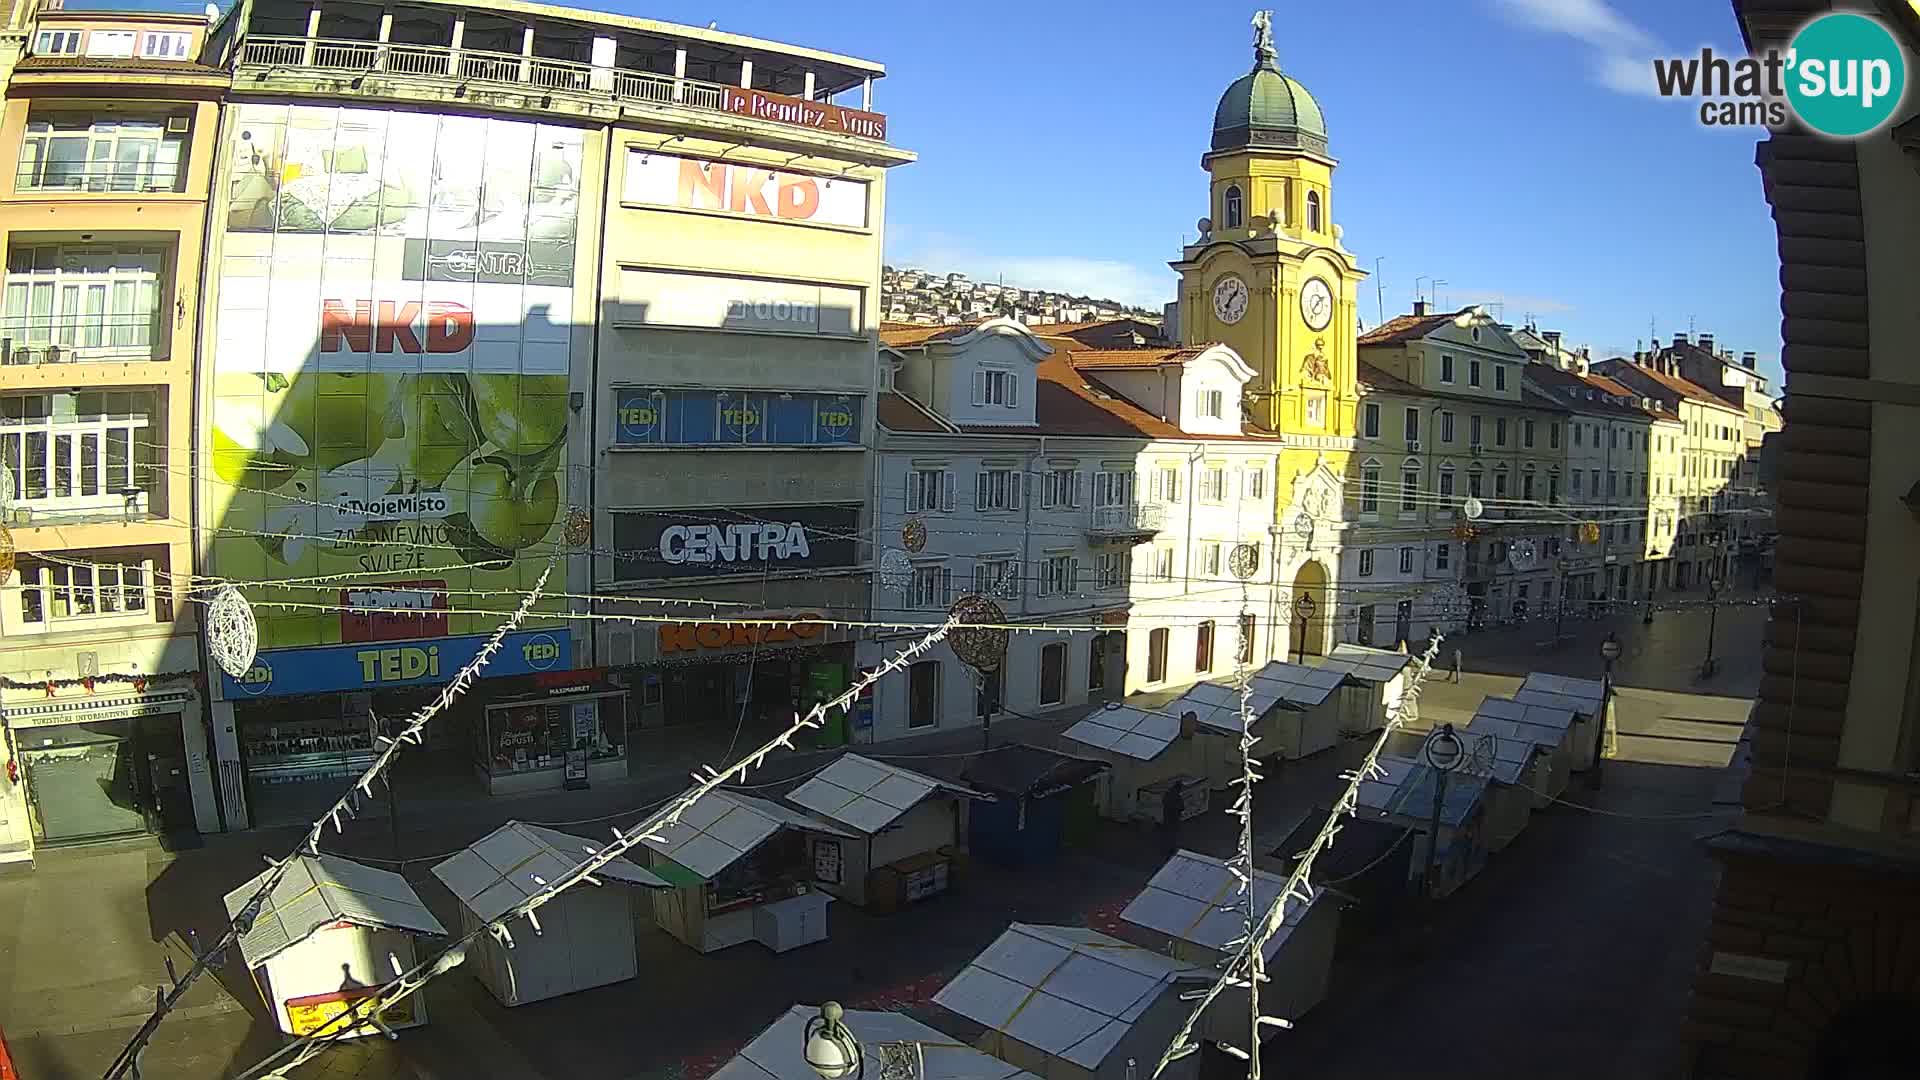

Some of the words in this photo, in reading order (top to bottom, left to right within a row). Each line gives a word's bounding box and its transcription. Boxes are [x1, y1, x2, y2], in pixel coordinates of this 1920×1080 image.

[722, 88, 745, 113] Le
[679, 159, 820, 219] NKD
[448, 249, 535, 277] CENTRA
[320, 298, 476, 354] NKD
[618, 407, 657, 425] TEDi
[722, 408, 759, 425] TEDi
[819, 411, 853, 426] TEDi
[337, 497, 446, 516] #TvojeMisto
[659, 521, 810, 564] CENTRA
[522, 643, 560, 662] TEDi
[242, 666, 273, 684] EDi
[357, 646, 440, 682] TEDi
